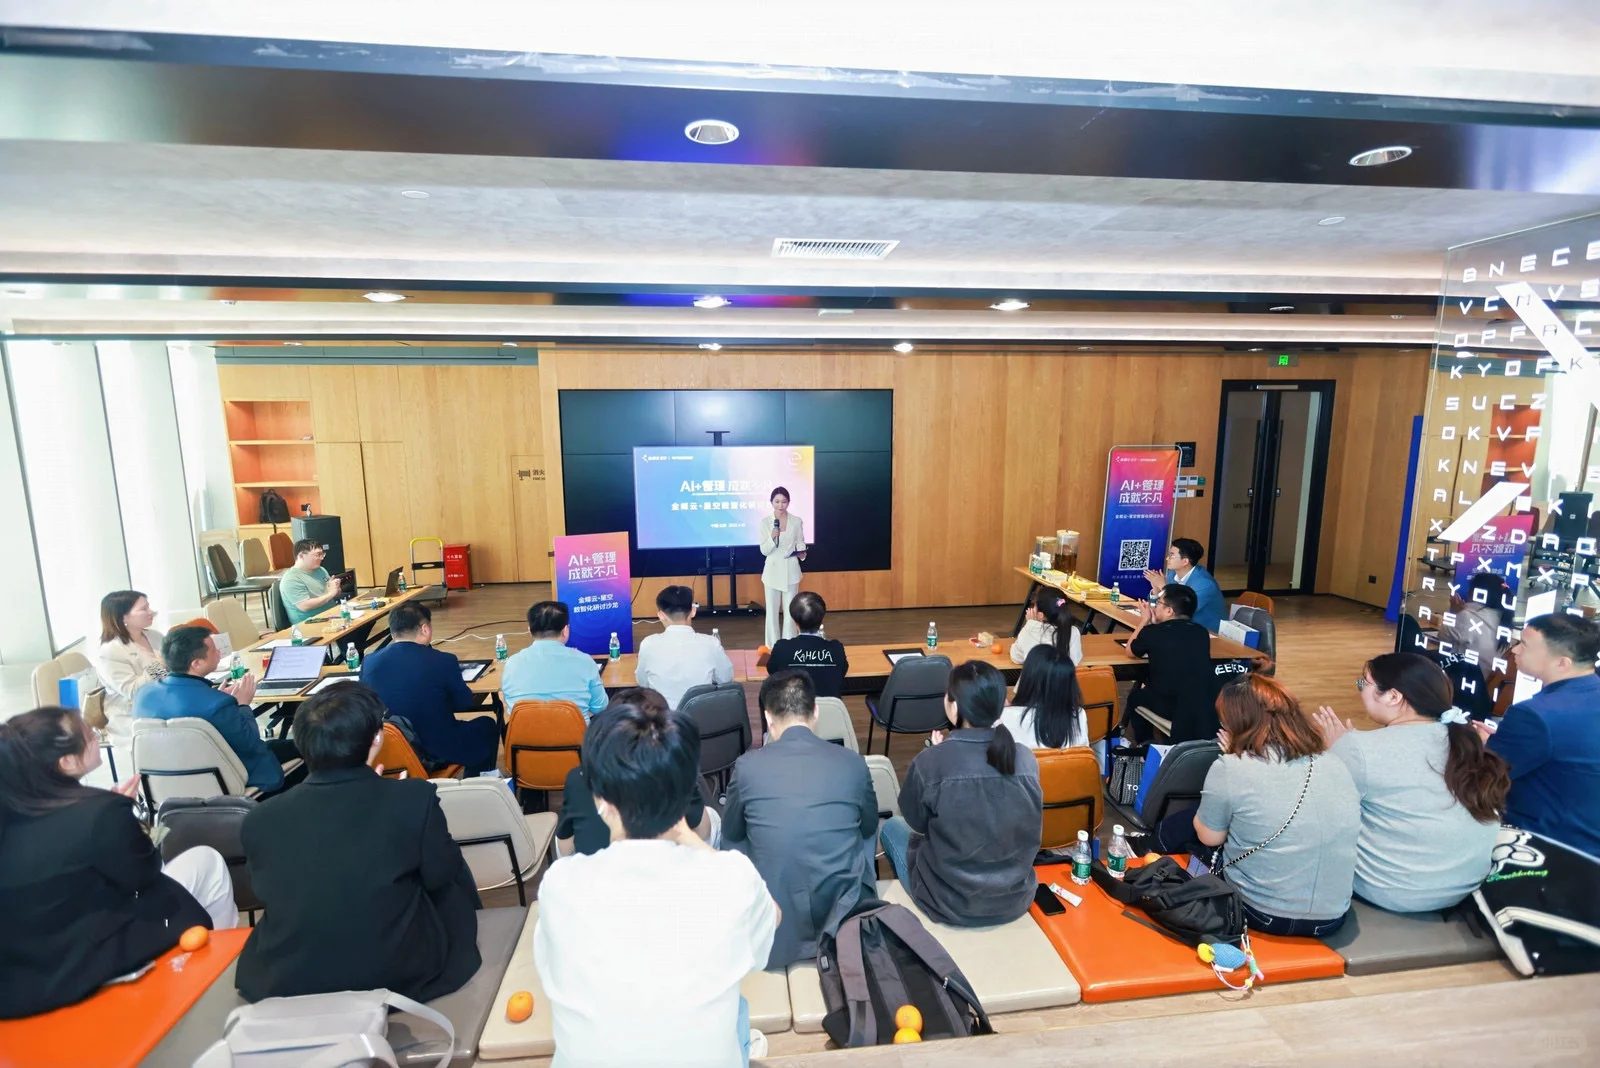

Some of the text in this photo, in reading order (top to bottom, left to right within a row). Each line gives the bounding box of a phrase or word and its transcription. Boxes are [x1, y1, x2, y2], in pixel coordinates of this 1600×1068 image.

[1120, 479, 1164, 491] AI+管理
[1119, 492, 1163, 504] 成就不凡
[568, 551, 617, 567] AI+管理
[568, 565, 618, 580] 成就不凡
